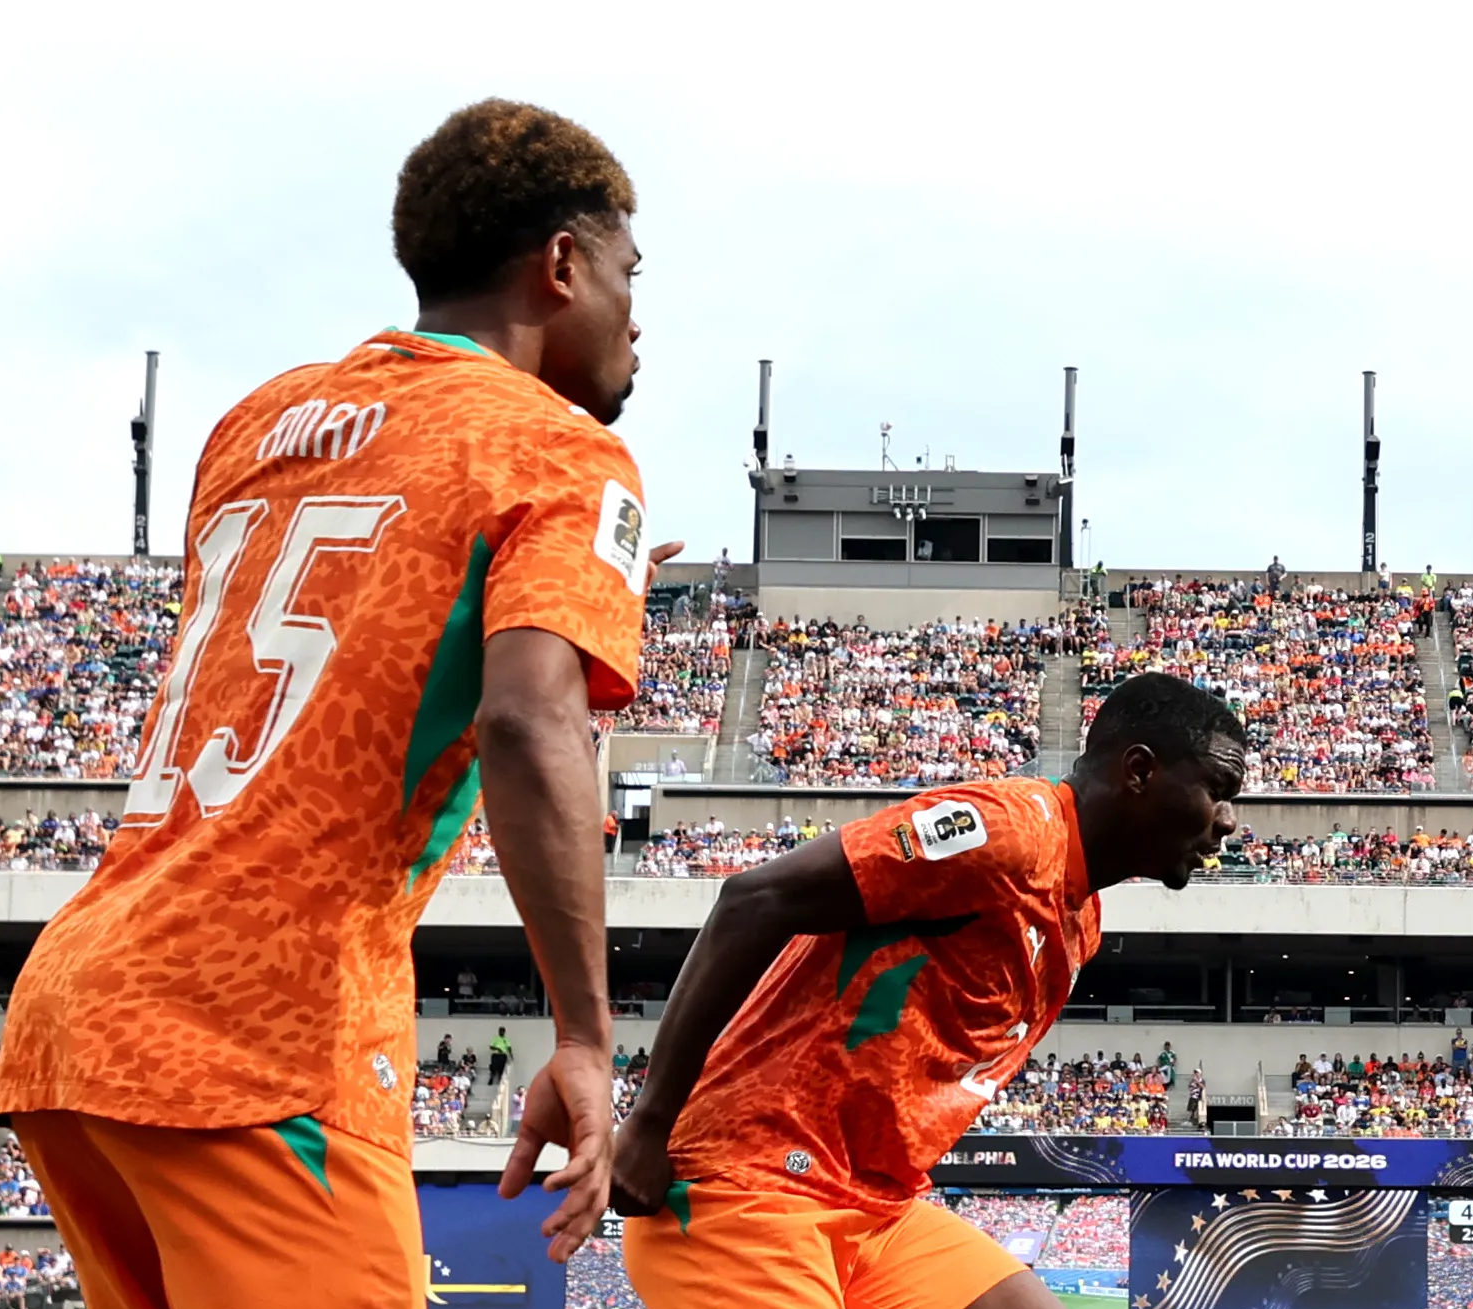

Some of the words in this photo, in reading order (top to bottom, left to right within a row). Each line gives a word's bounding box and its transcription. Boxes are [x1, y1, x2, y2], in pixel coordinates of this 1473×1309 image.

[1365, 532, 1375, 565] 211
[120, 495, 407, 828] 15
[938, 1151, 1017, 1166] DELPHIA
[1174, 1153, 1214, 1168] FIFA
[1215, 1153, 1282, 1168] WORLD
[1284, 1153, 1321, 1168] CUP
[1323, 1153, 1388, 1169] 2026
